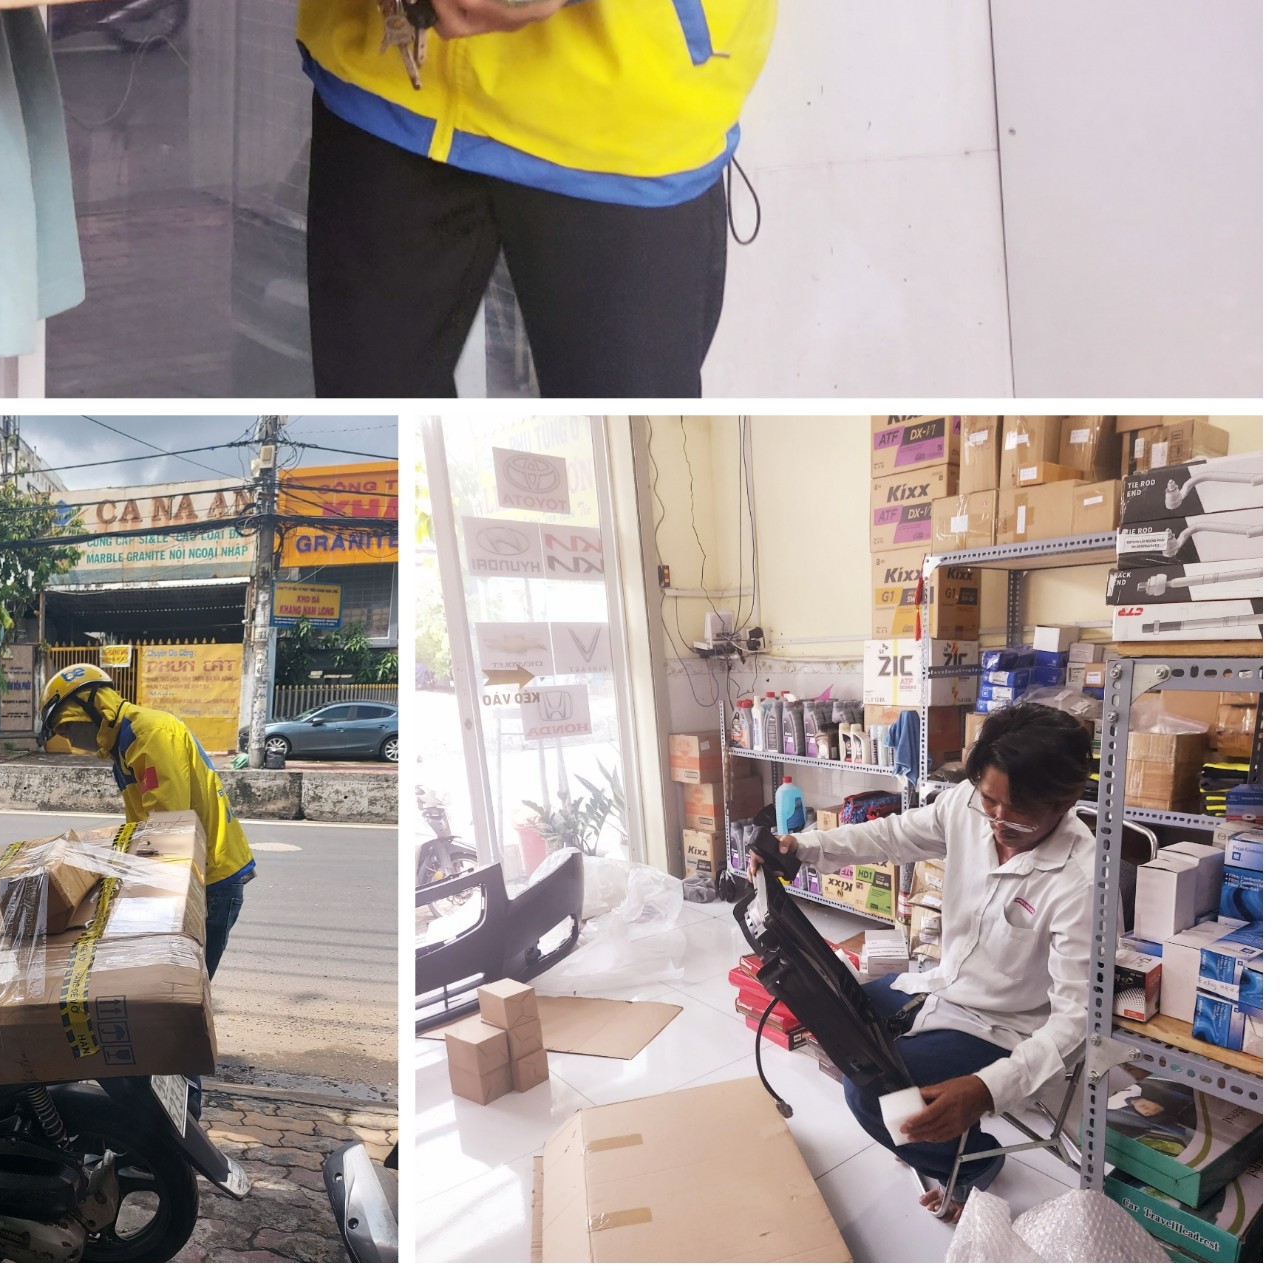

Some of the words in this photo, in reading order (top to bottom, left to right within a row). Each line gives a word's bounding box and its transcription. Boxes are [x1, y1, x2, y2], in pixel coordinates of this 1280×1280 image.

[878, 430, 900, 447] ATF
[1127, 481, 1139, 490] TIE
[1140, 479, 1156, 488] ROD
[886, 483, 931, 504] Kixx
[1126, 489, 1142, 498] END
[96, 498, 143, 525] CA
[151, 493, 199, 522] NA
[878, 508, 898, 523] ATF
[1137, 526, 1153, 535] ROD
[295, 531, 398, 554] GRANITE
[86, 551, 124, 565] MARBLE
[126, 549, 166, 563] GRANITE
[946, 566, 974, 581] Kixx
[881, 590, 895, 603] G1
[146, 660, 195, 673] PHUN
[878, 654, 914, 677] ZIC
[60, 667, 86, 682] be
[687, 845, 708, 857] Kixx
[828, 877, 854, 892] Kixx
[1121, 1196, 1140, 1213] Car
